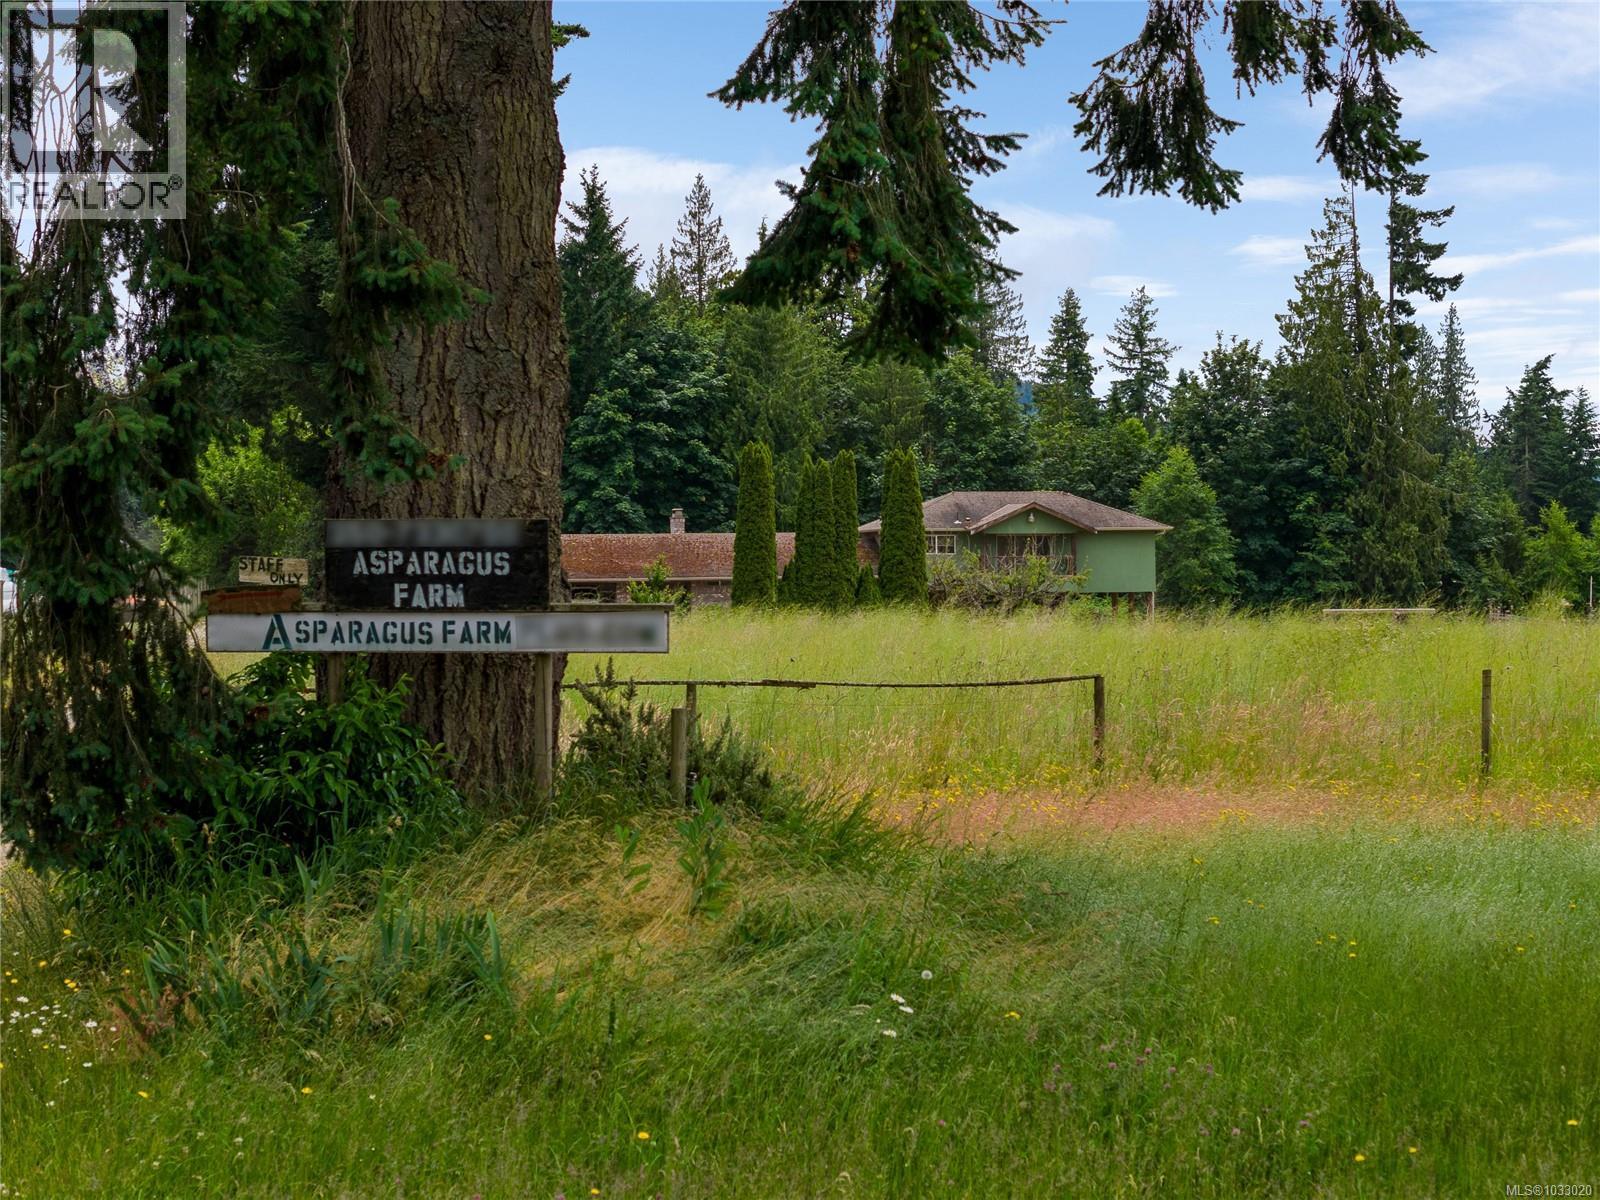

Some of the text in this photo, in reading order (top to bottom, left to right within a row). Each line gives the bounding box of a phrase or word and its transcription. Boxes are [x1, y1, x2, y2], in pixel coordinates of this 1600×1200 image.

[239, 556, 284, 572] STAFF
[352, 550, 511, 577] ASPARAGUS
[270, 572, 304, 584] ONLY
[394, 583, 465, 609] FARM
[262, 614, 433, 650] ASPARAGUS
[442, 619, 512, 645] FARM
